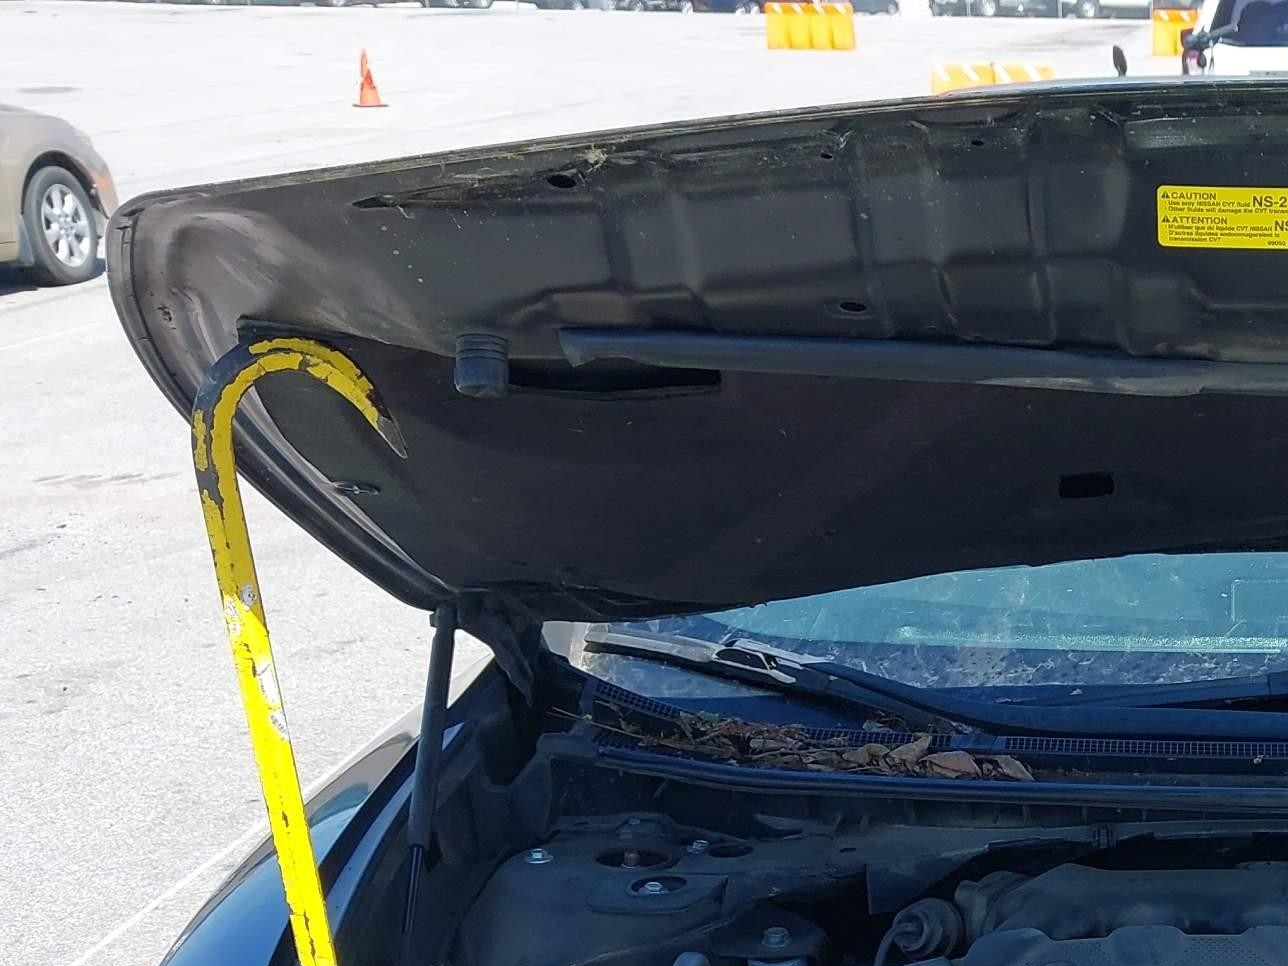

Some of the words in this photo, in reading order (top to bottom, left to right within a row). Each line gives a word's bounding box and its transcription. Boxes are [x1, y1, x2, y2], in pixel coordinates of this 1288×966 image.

[1171, 192, 1217, 200] CAUTION
[1253, 196, 1287, 208] NS-2
[1171, 216, 1228, 225] ATTENTION
